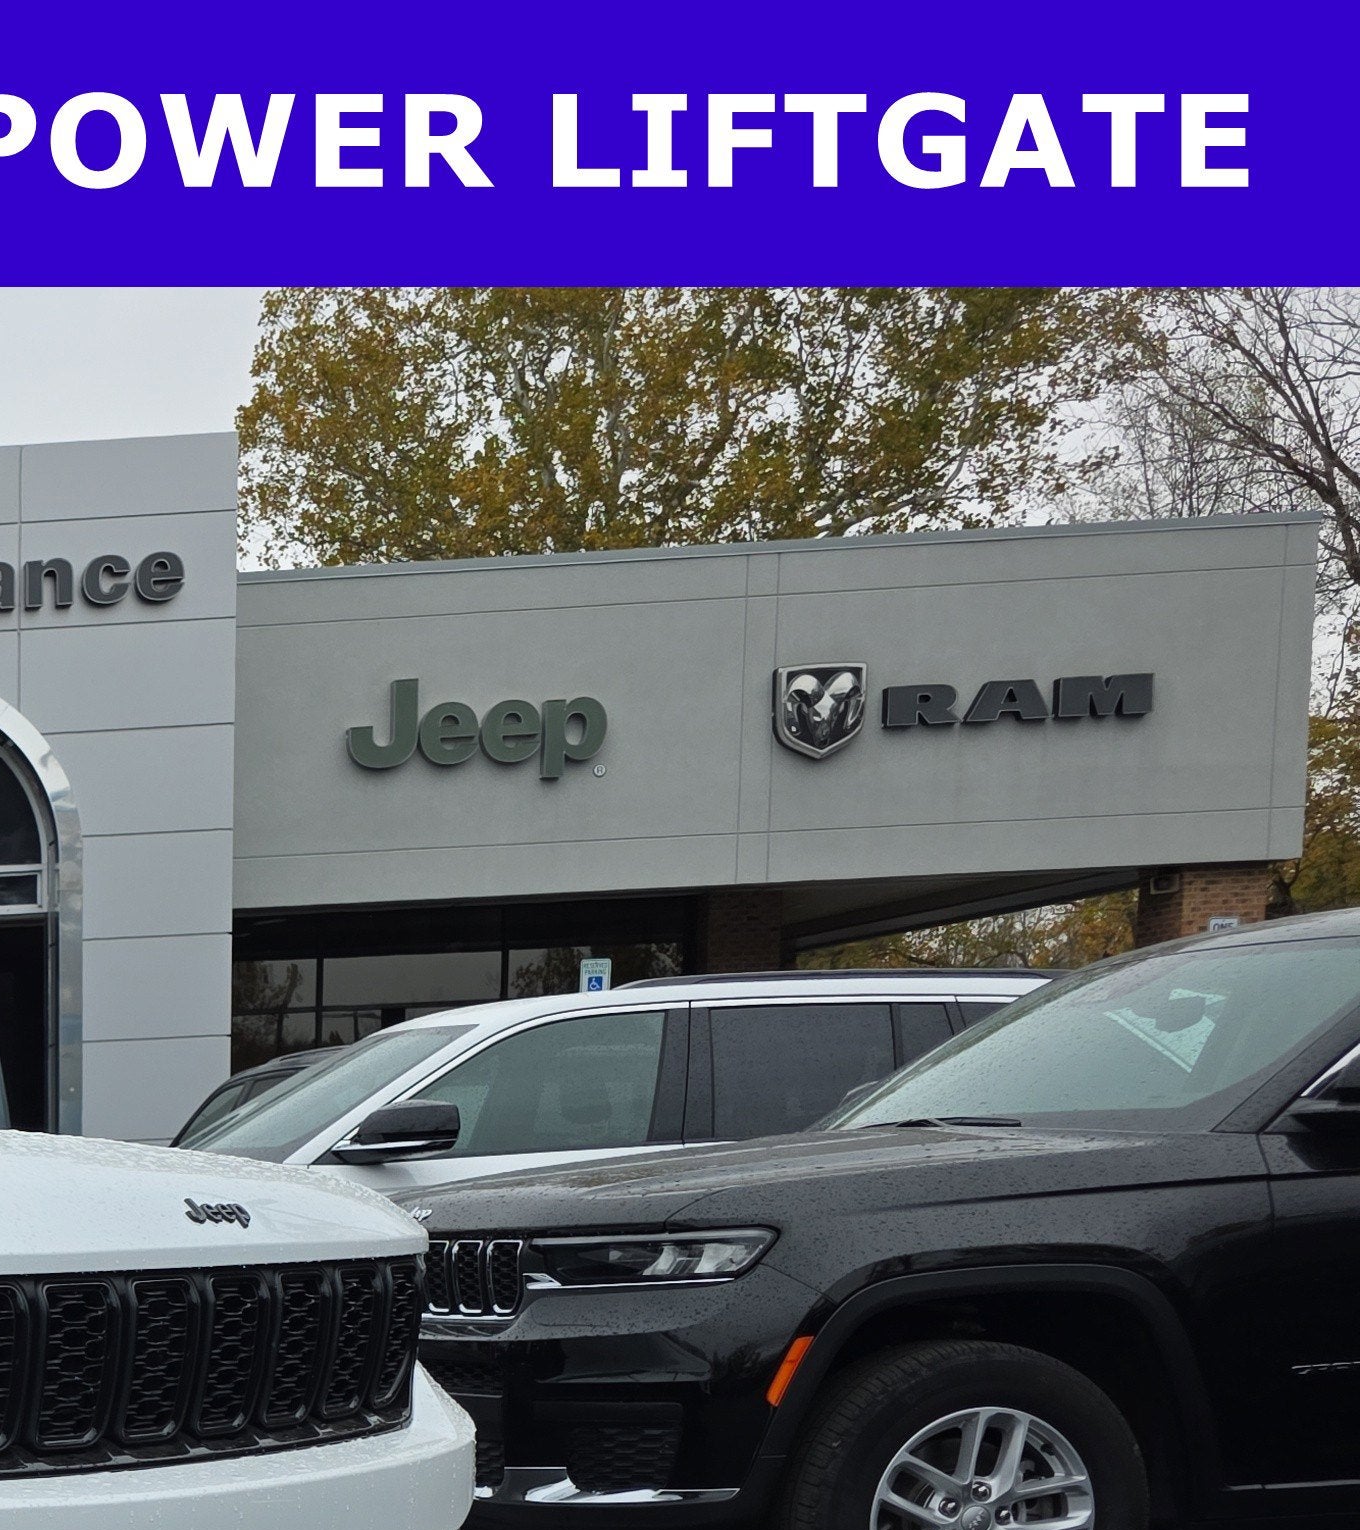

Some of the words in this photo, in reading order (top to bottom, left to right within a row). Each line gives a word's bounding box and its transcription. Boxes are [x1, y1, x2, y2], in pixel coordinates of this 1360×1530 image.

[345, 678, 608, 782] Jeep
[881, 672, 1155, 730] RAM
[183, 1197, 251, 1229] Jeep
